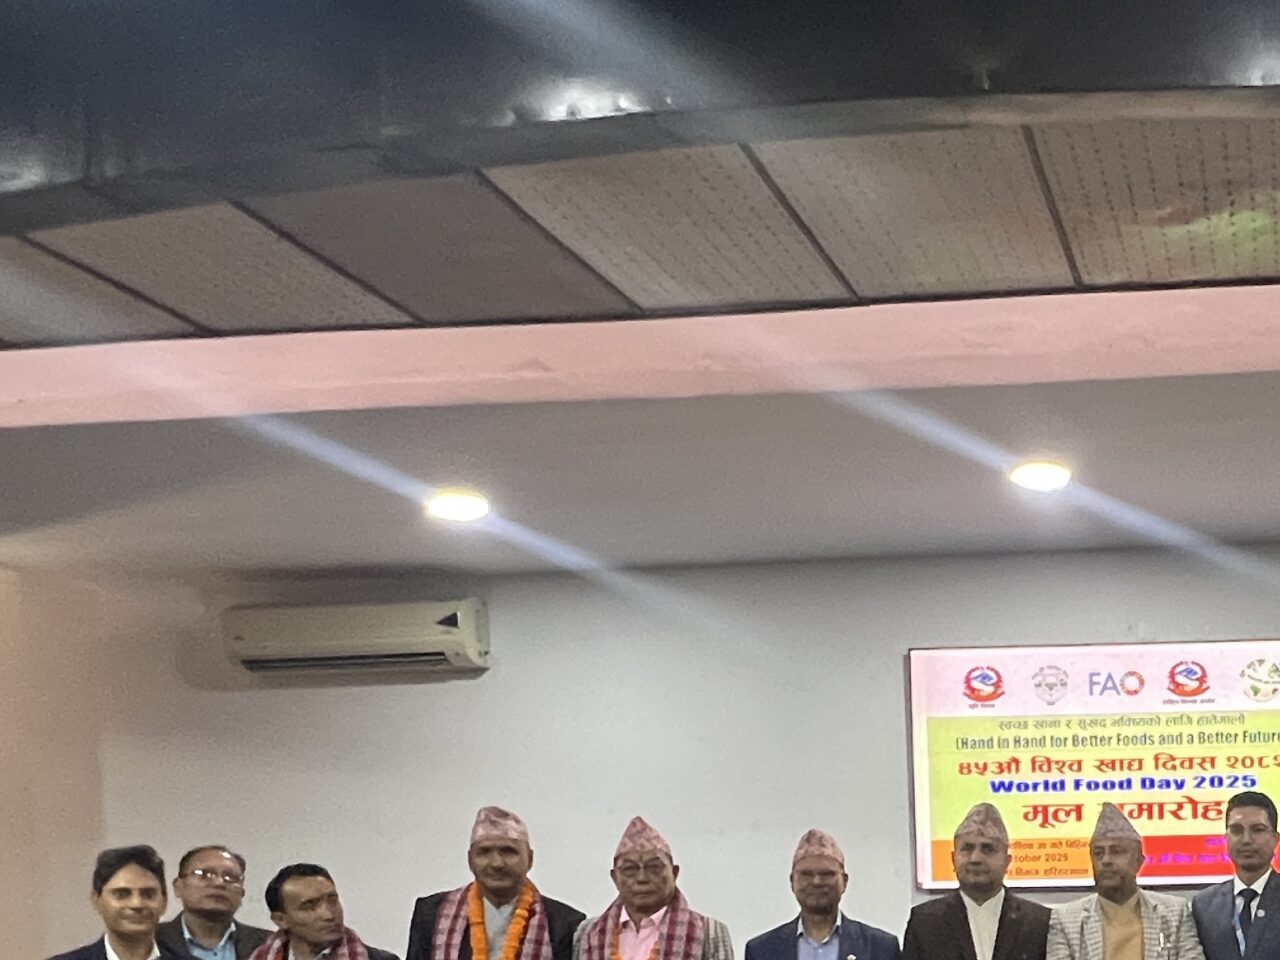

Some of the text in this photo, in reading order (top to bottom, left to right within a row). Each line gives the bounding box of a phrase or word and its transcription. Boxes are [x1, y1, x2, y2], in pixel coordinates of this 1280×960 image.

[1065, 719, 1073, 729] र
[1078, 718, 1107, 731] सुखद
[997, 736, 1010, 749] in
[1013, 735, 1046, 748] Hand
[1050, 735, 1068, 748] for
[1072, 733, 1112, 748] Better
[1116, 732, 1155, 746] Foods
[1159, 731, 1183, 745] and
[1186, 733, 1194, 744] a
[1199, 731, 1239, 745] Better
[1031, 755, 1083, 774] विश्व
[1093, 757, 1144, 773] खाद्य
[1154, 752, 1217, 771] दिवस
[990, 774, 1257, 793] World Food Day 2025
[1022, 796, 1225, 828] मूल मारोह
[1045, 853, 1069, 862] 2025
